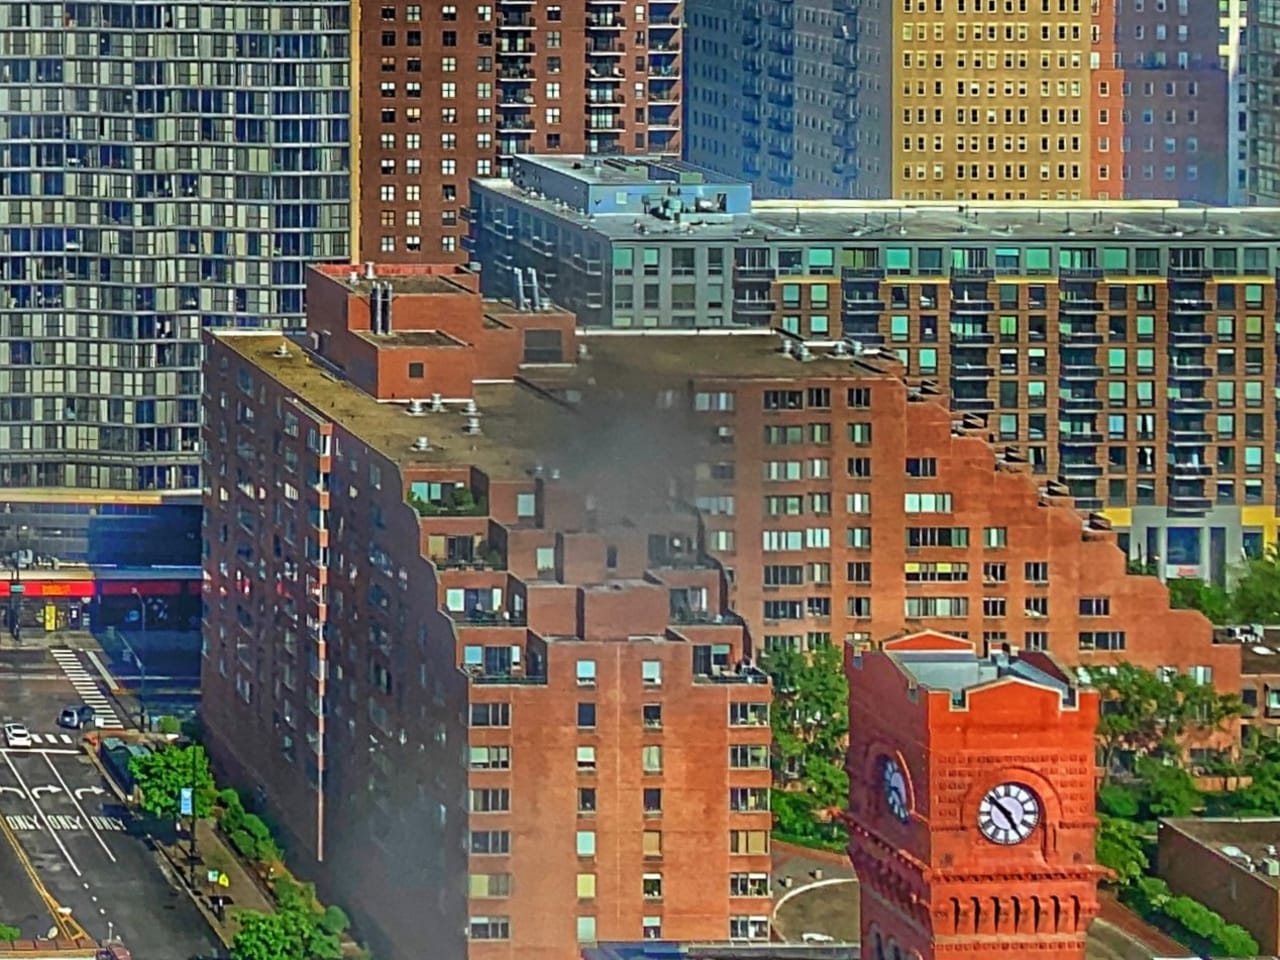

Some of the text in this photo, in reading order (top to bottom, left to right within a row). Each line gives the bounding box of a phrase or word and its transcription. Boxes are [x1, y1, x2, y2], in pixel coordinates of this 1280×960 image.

[6, 815, 41, 829] ONLY
[48, 815, 83, 829] ONLY
[91, 816, 127, 830] ONLY
